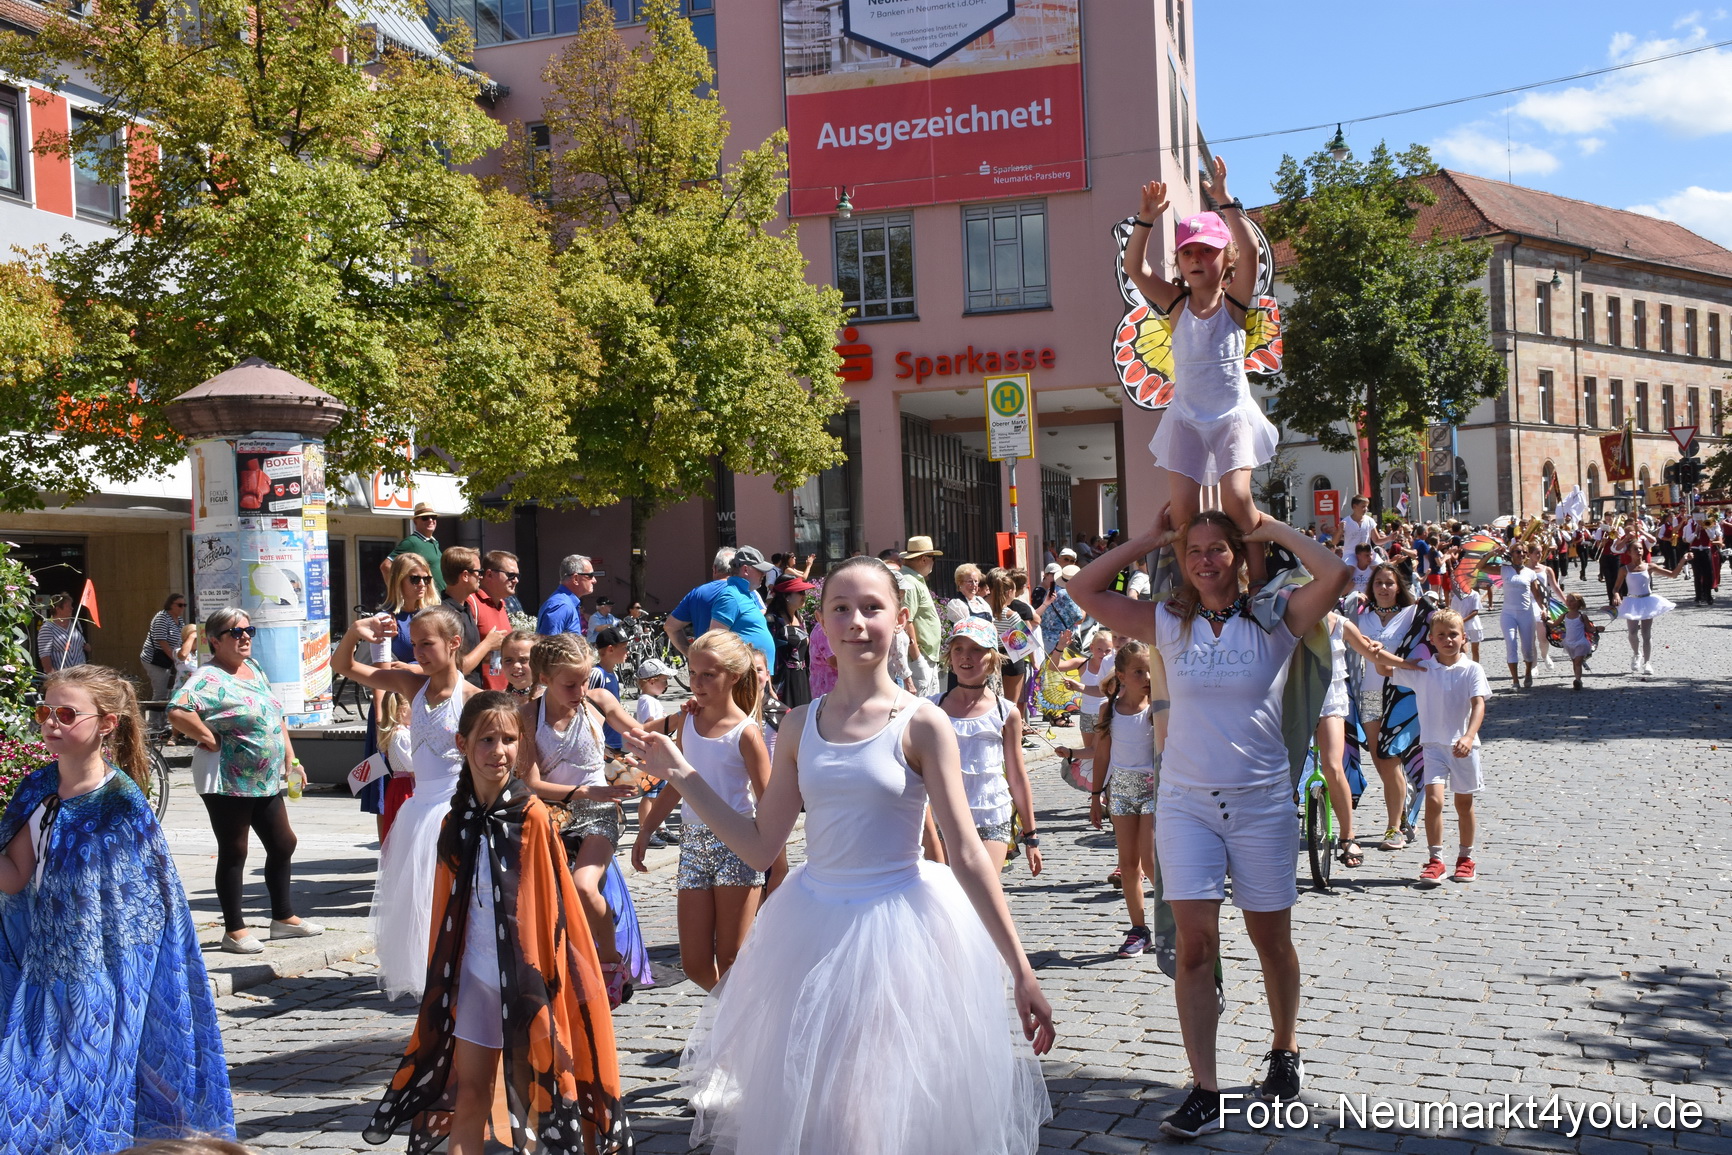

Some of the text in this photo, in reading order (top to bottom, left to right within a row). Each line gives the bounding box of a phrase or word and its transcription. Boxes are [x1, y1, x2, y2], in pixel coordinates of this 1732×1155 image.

[876, 8, 905, 18] Banken
[916, 2, 956, 12] Neumarkt
[890, 26, 935, 37] Internationales
[935, 23, 958, 32] Institut
[900, 31, 959, 44] Bankentests GmbH
[816, 97, 1053, 150] Ausgezeichnet!
[993, 164, 1033, 175] Sparkasse
[993, 171, 1071, 184] Neumarkt-Parsberg
[895, 345, 1056, 384] Sparkasse
[1000, 389, 1016, 408] H
[265, 456, 301, 468] BOXEN
[209, 489, 229, 497] FOKUS
[1176, 668, 1252, 682] art of sports
